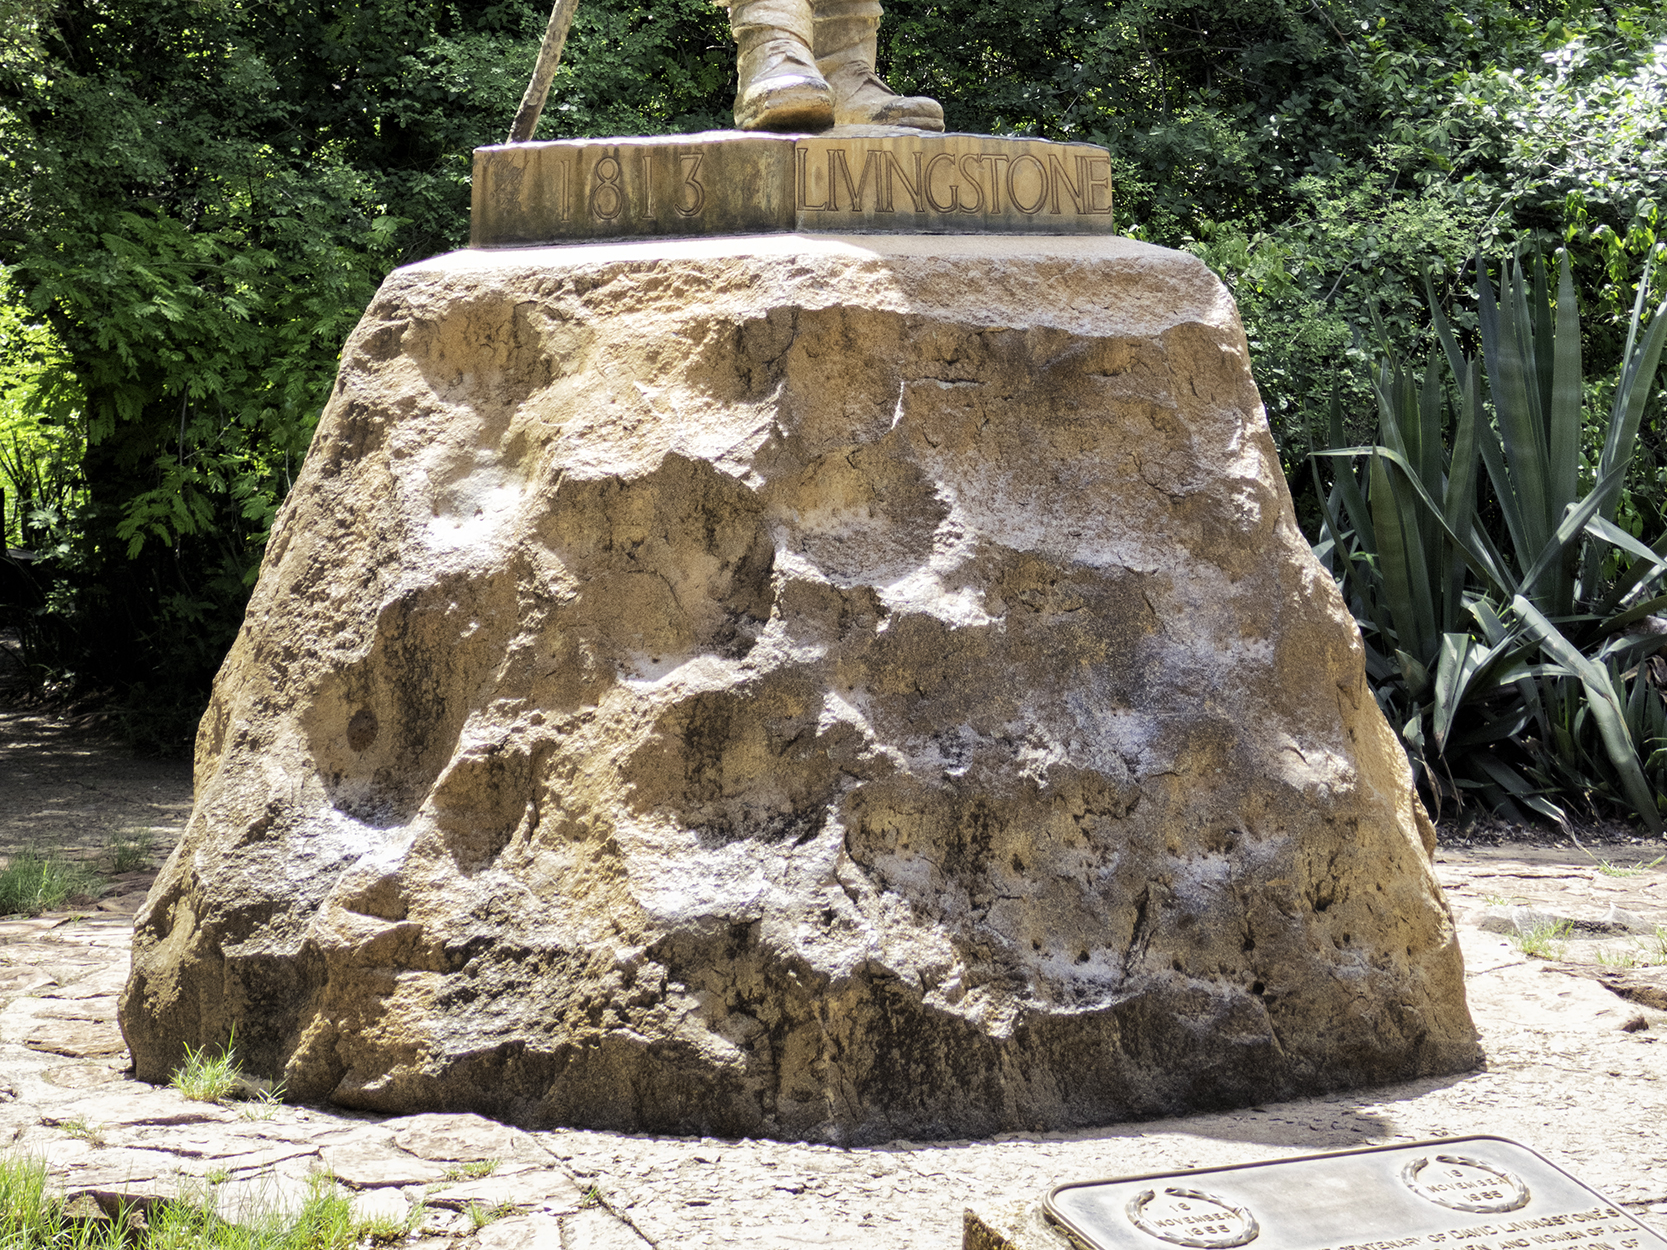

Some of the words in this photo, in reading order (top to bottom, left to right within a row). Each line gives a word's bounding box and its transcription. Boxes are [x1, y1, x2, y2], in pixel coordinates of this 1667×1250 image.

[559, 152, 705, 223] 1813
[796, 147, 1112, 215] LIVINGSTONE
[1425, 1177, 1508, 1193] NOVEMBER
[1154, 1212, 1236, 1228] NOVEMBER
[1447, 1225, 1498, 1240] DAVID
[1498, 1238, 1530, 1250] AND
[1586, 1226, 1604, 1236] OF
[1608, 1223, 1638, 1234] ALL
